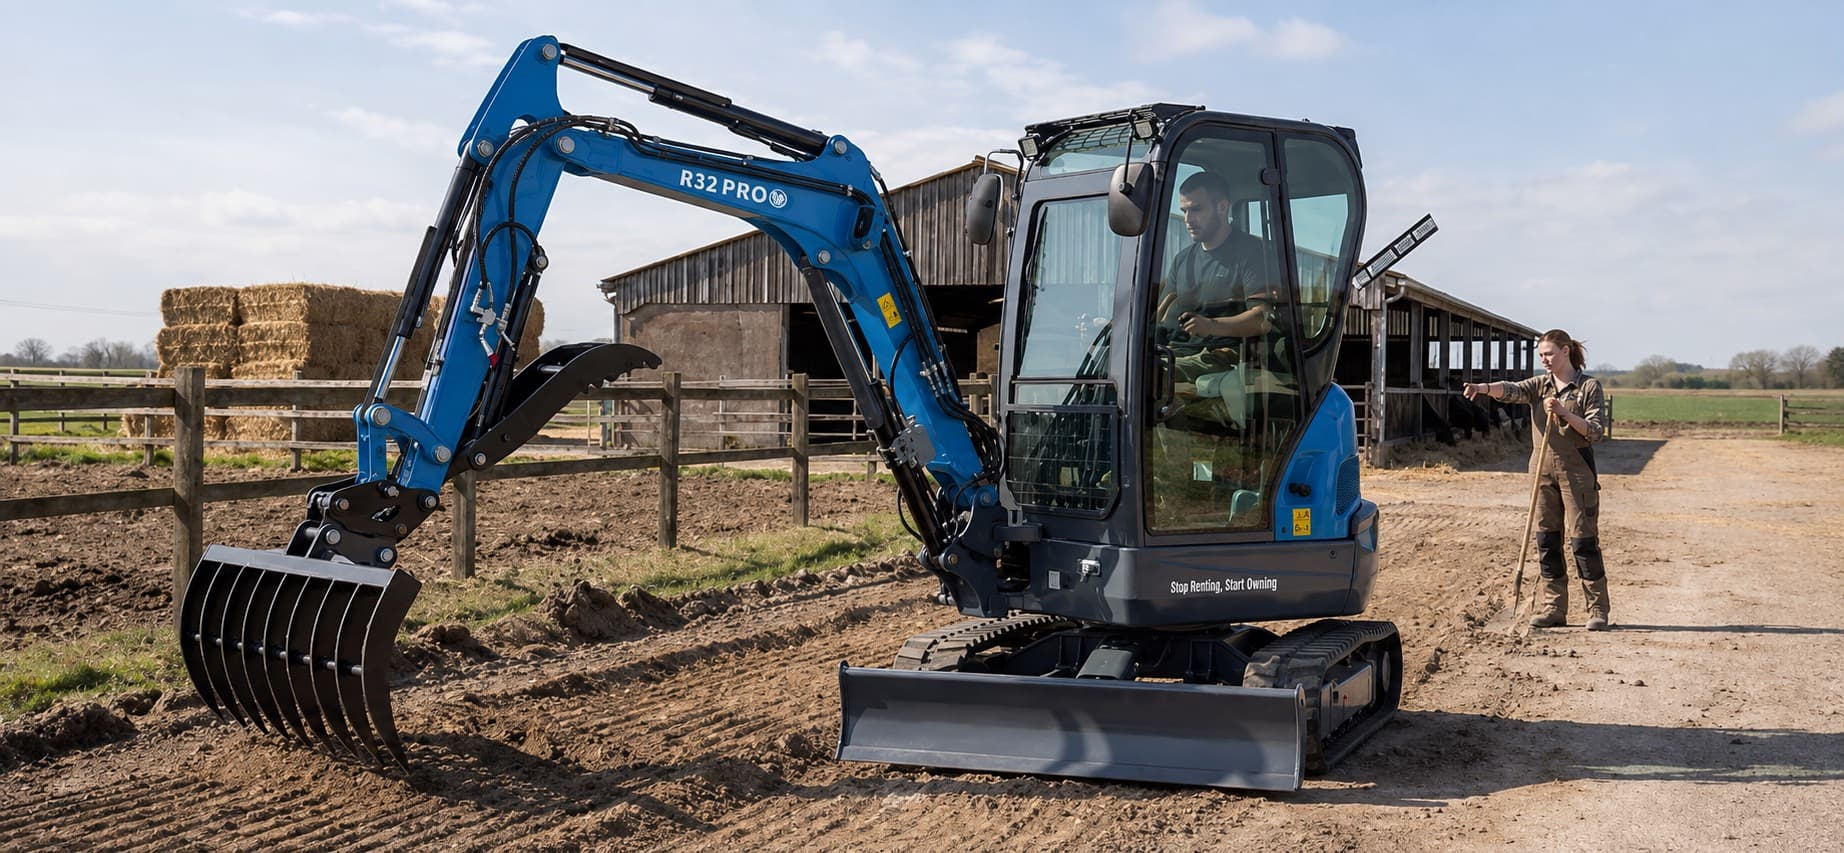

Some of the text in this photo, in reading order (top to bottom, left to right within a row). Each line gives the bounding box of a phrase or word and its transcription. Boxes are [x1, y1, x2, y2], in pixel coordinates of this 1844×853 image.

[680, 169, 767, 203] R32 PRO
[1170, 576, 1277, 595] Stop Renting, Start Owning
